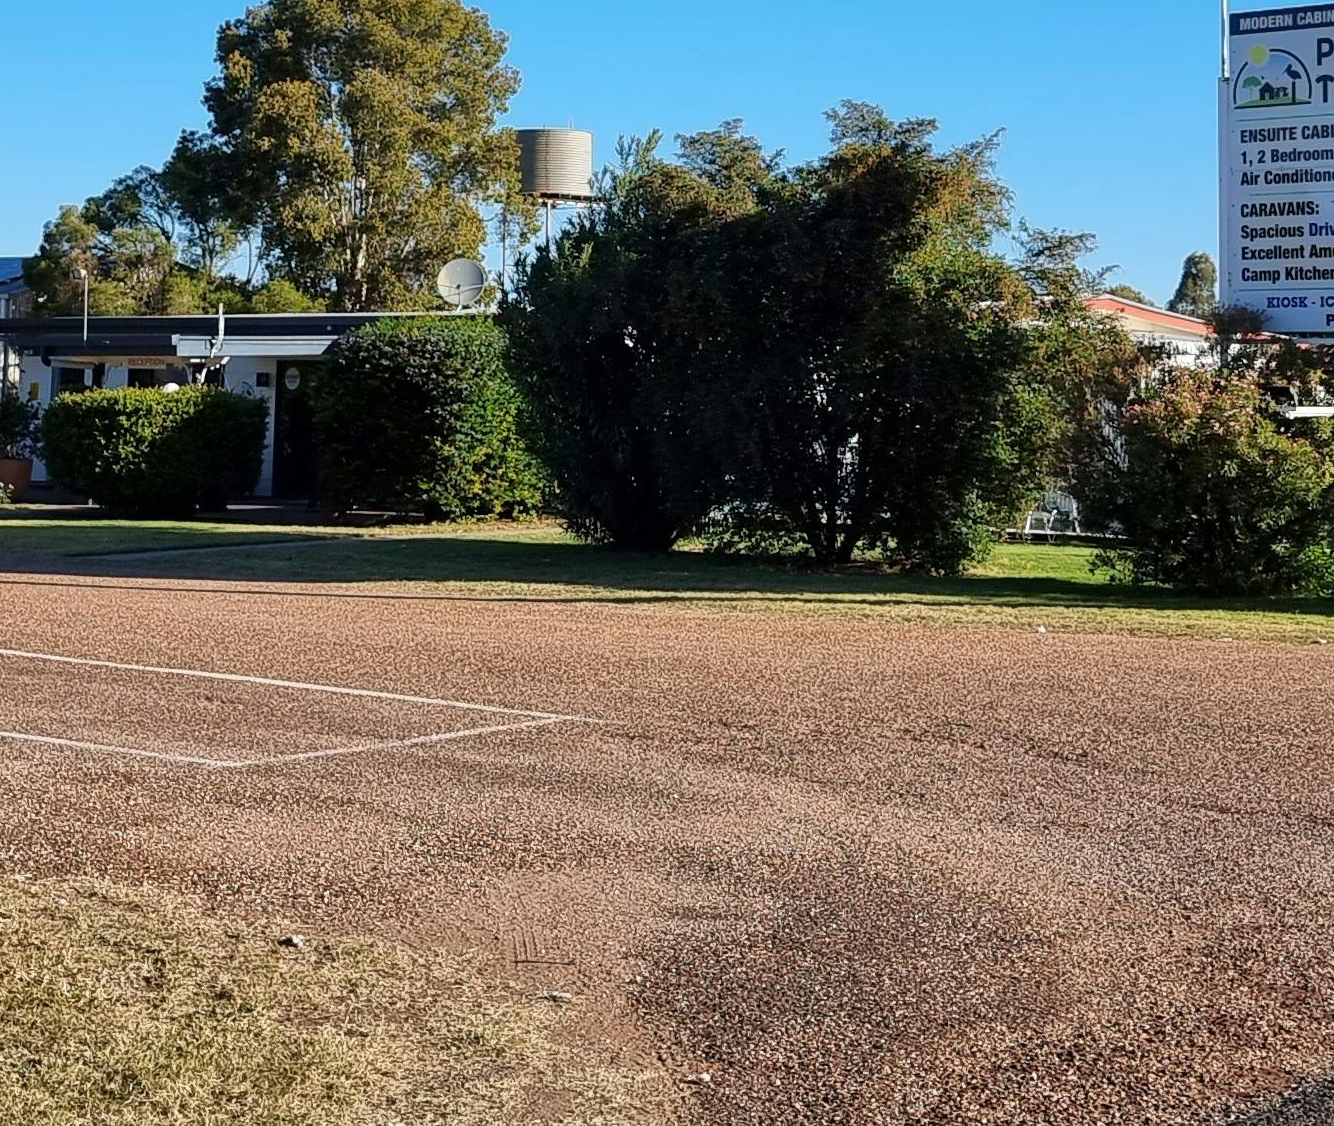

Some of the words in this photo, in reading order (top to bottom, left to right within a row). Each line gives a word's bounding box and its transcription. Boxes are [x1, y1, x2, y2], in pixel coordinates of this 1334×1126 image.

[1239, 14, 1293, 31] MODERN
[1240, 126, 1298, 144] ENSUITE
[1240, 150, 1253, 167] 1,
[1257, 149, 1266, 164] 2
[1270, 147, 1334, 163] Bedroom
[1240, 171, 1260, 186] Air
[1240, 200, 1320, 218] CARAVANS:
[1240, 223, 1305, 242] Spacious
[1241, 244, 1306, 261] Excellent
[1241, 267, 1281, 284] Camp
[1267, 296, 1308, 308] KIOSK
